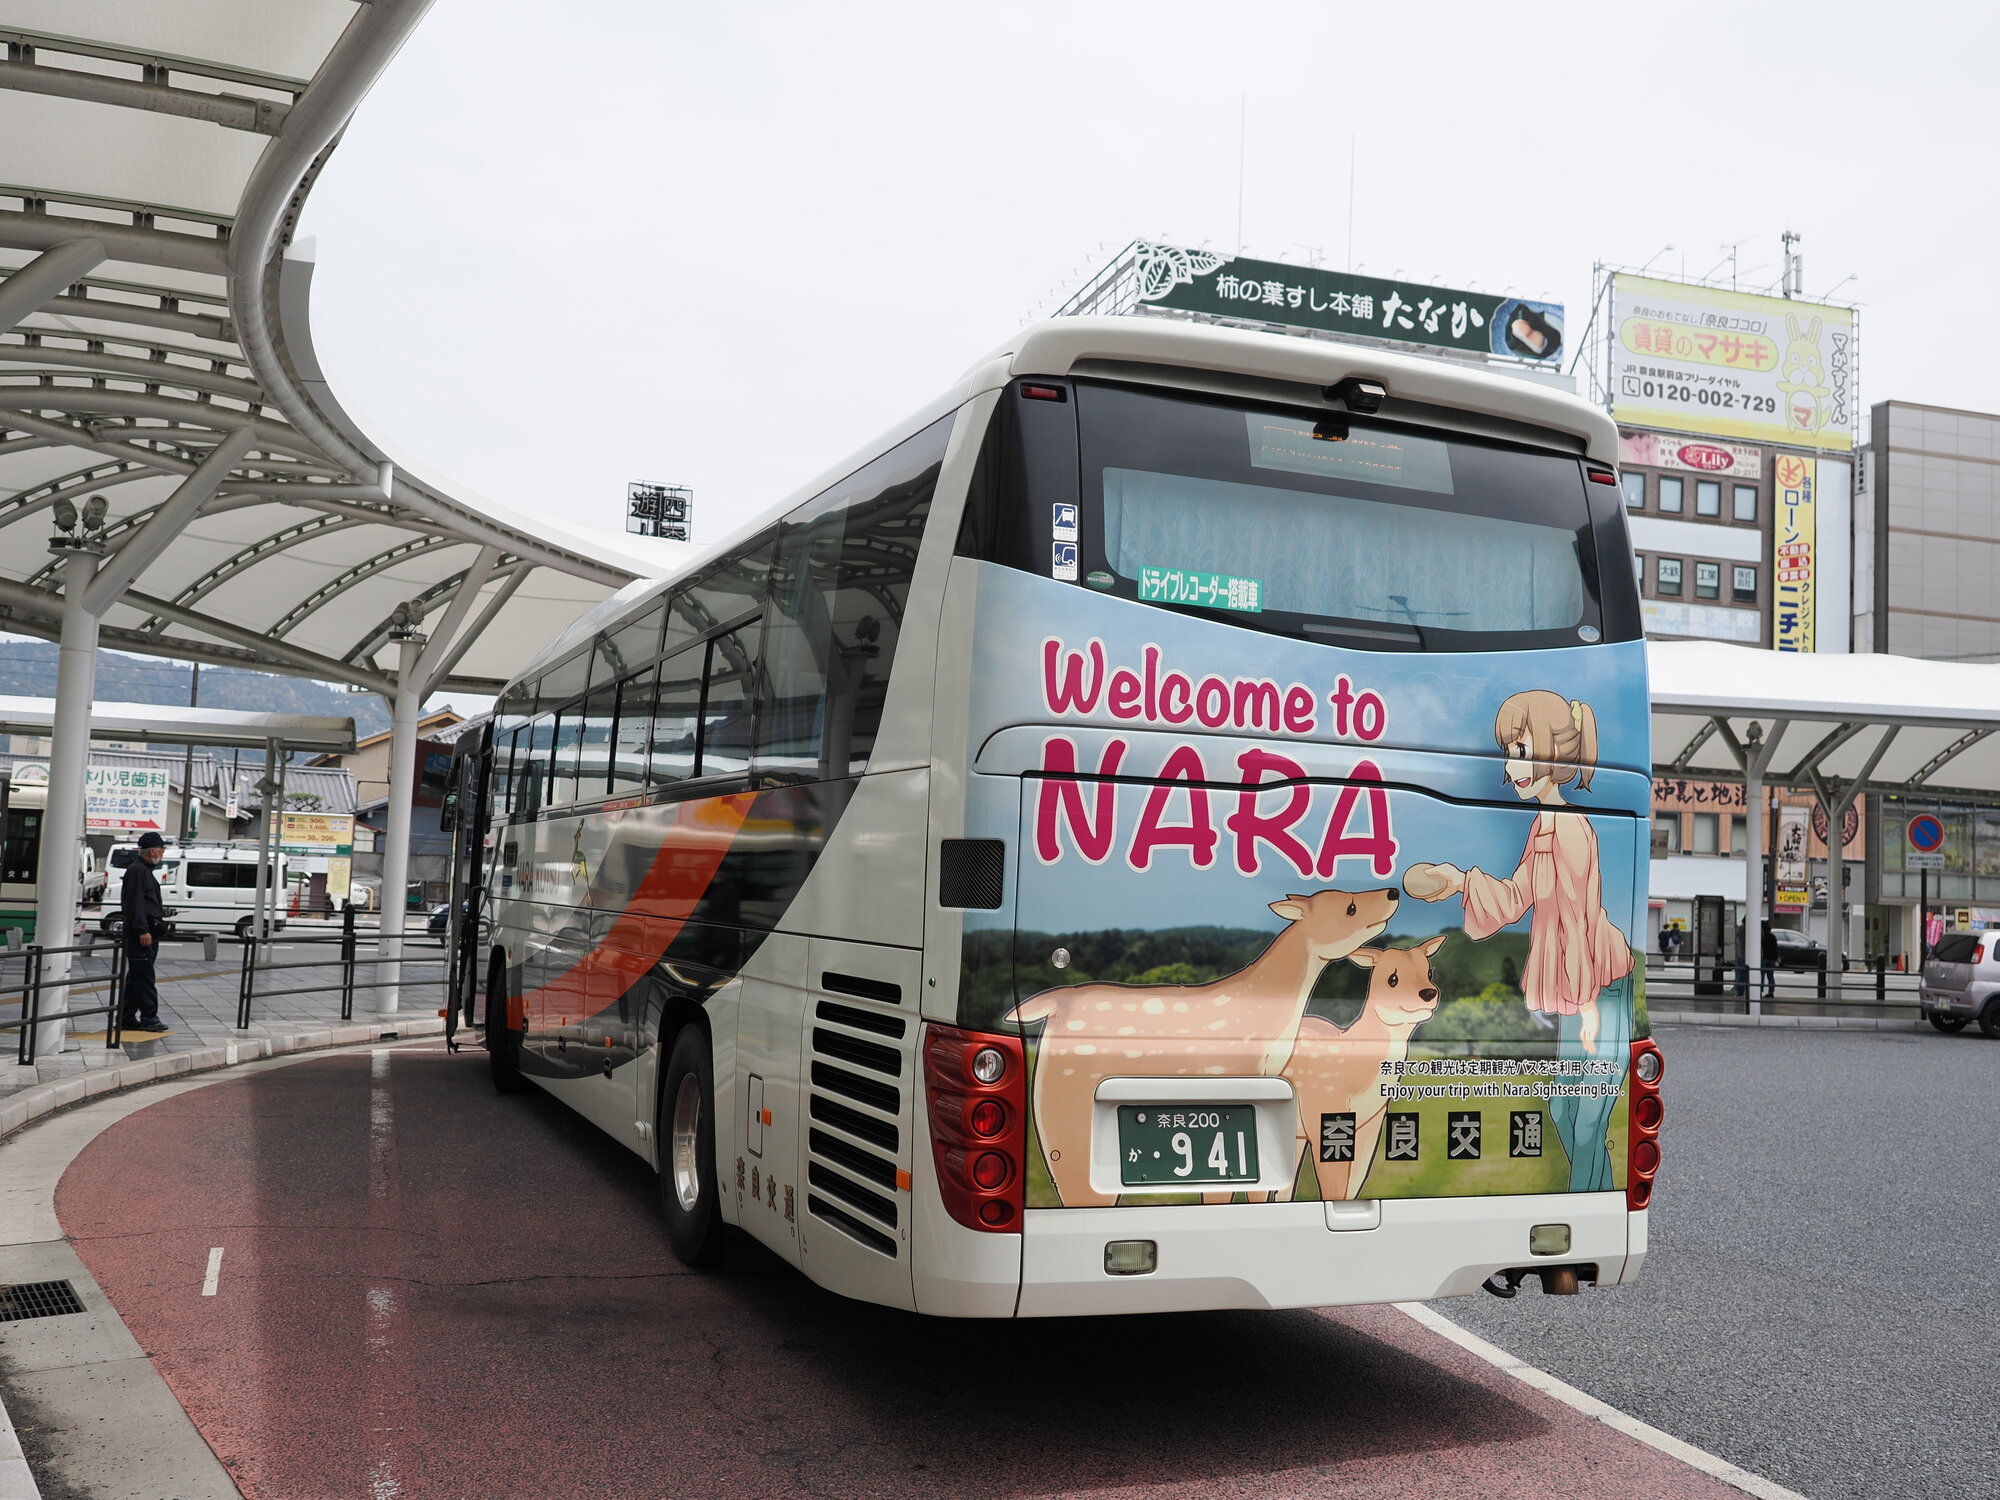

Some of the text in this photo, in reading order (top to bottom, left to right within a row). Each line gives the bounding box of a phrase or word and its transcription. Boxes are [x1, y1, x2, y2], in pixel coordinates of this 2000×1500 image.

[1216, 273, 1485, 338] 柿の葉すし本舗 たなか
[1632, 323, 1769, 368] 賃貸のマサキ
[1643, 381, 1776, 413] 0120-002-729
[1701, 452, 1729, 469] Lily
[1784, 490, 1799, 543] ローン
[1142, 568, 1258, 610] ドライブレコーダー搭載車
[1041, 637, 1317, 736] Welcome
[1328, 674, 1387, 742] to
[1034, 734, 1398, 881] NARA
[1783, 895, 1801, 903] OPEN
[1380, 1060, 1622, 1076] 奈良での観光は定期観光バスをご利用ください。
[1380, 1083, 1414, 1100] Enjoy
[1417, 1086, 1446, 1100] your
[1449, 1083, 1470, 1099] trip
[1473, 1082, 1500, 1097] with
[1503, 1083, 1530, 1097] Nara
[1533, 1082, 1598, 1099] Sightseeing
[1157, 1112, 1220, 1129] 奈良200
[1322, 1113, 1542, 1160] 奈良交通
[1128, 1148, 1142, 1162] か
